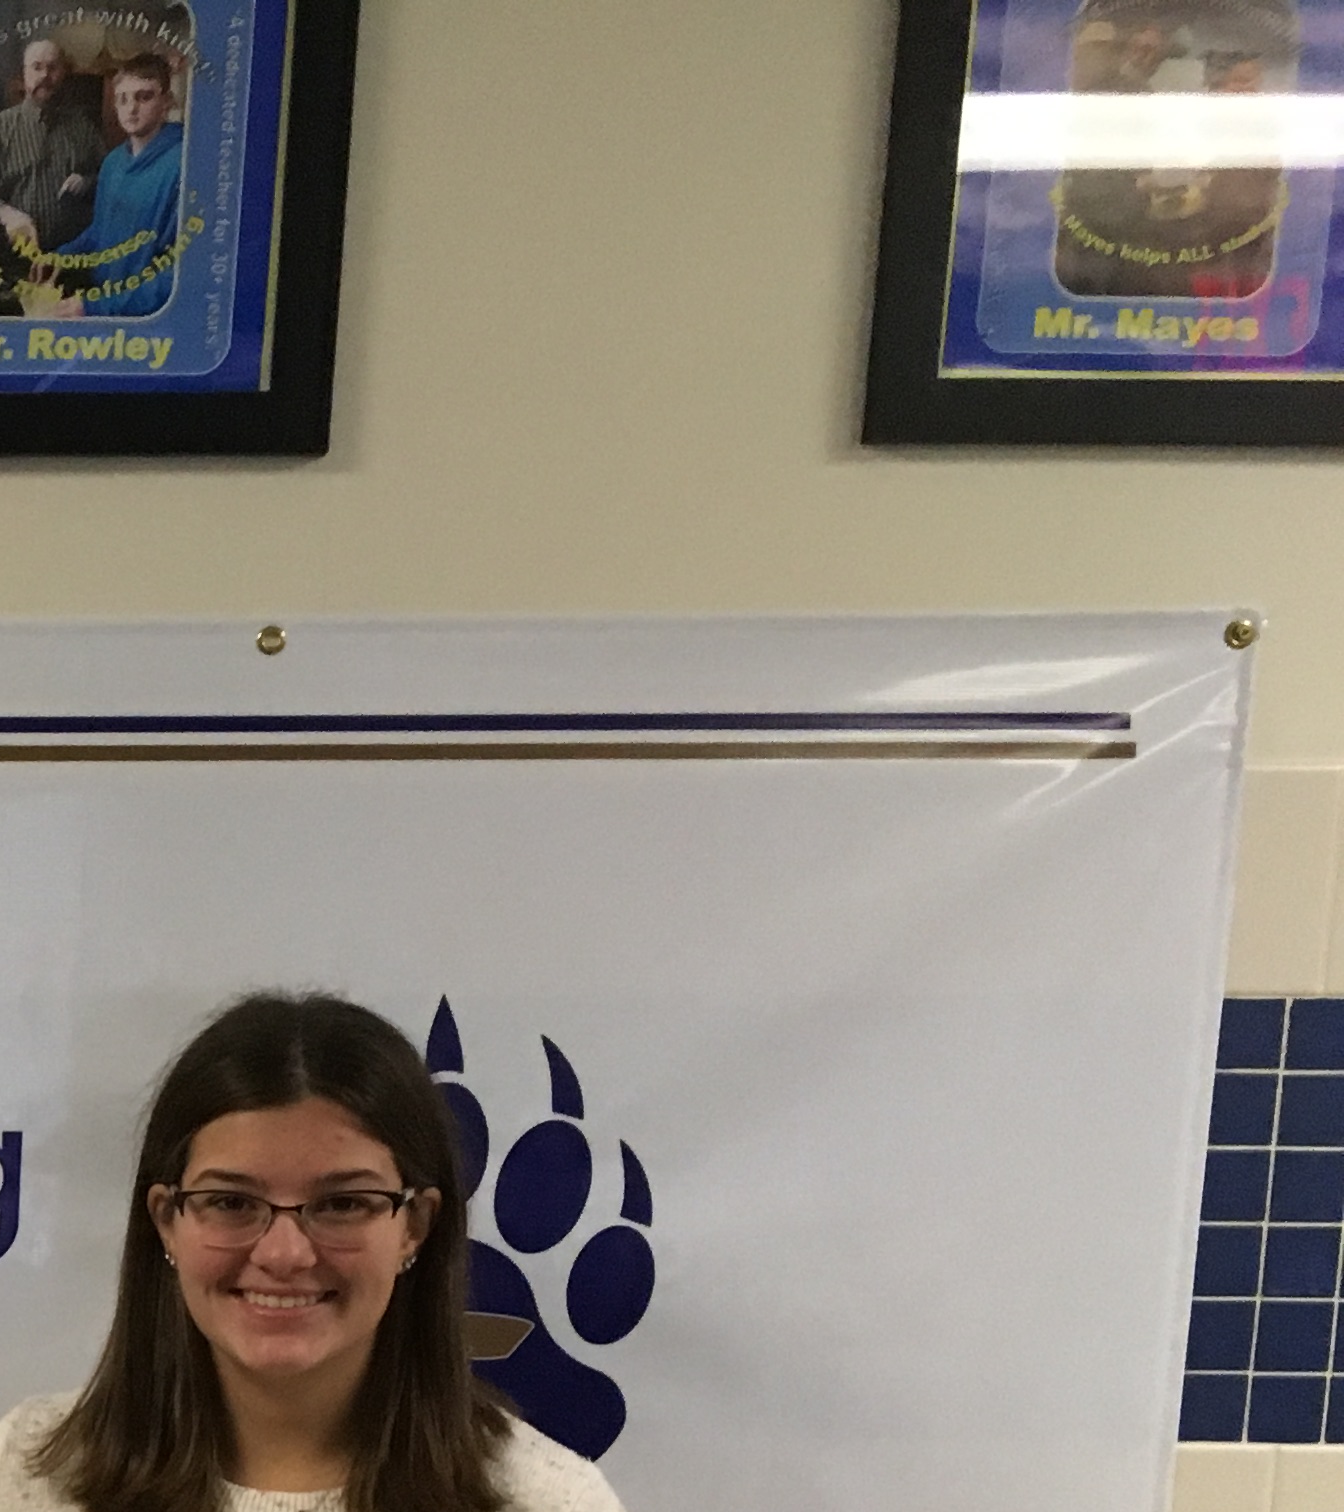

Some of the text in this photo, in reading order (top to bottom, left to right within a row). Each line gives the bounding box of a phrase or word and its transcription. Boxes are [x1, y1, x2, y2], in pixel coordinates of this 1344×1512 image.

[97, 11, 149, 33] with
[216, 138, 232, 211] teacher
[1176, 245, 1215, 264] ALL
[1034, 306, 1259, 348] Mr. Mayes
[27, 328, 173, 369] Rowley
